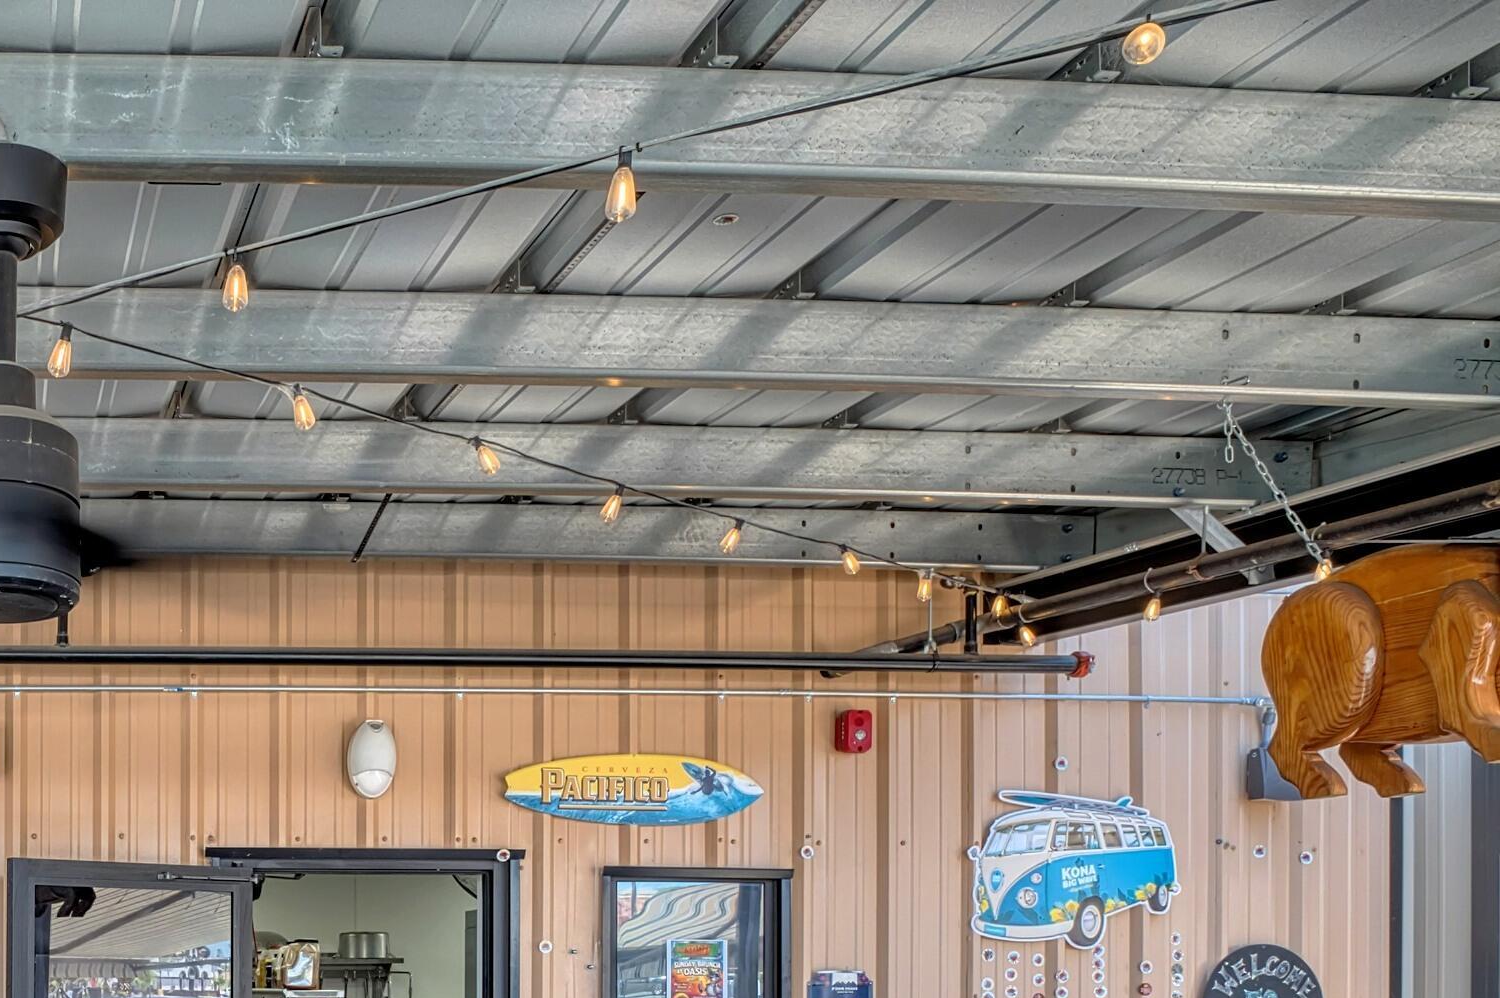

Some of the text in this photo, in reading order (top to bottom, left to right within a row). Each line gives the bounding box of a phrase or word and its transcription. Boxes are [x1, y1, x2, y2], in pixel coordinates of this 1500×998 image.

[1151, 467, 1206, 485] 27738
[581, 766, 669, 774] CERVEZA
[540, 767, 670, 804] PACIFICO
[1061, 864, 1097, 881] KONA
[1062, 878, 1078, 888] BIG
[683, 967, 708, 976] OASIS
